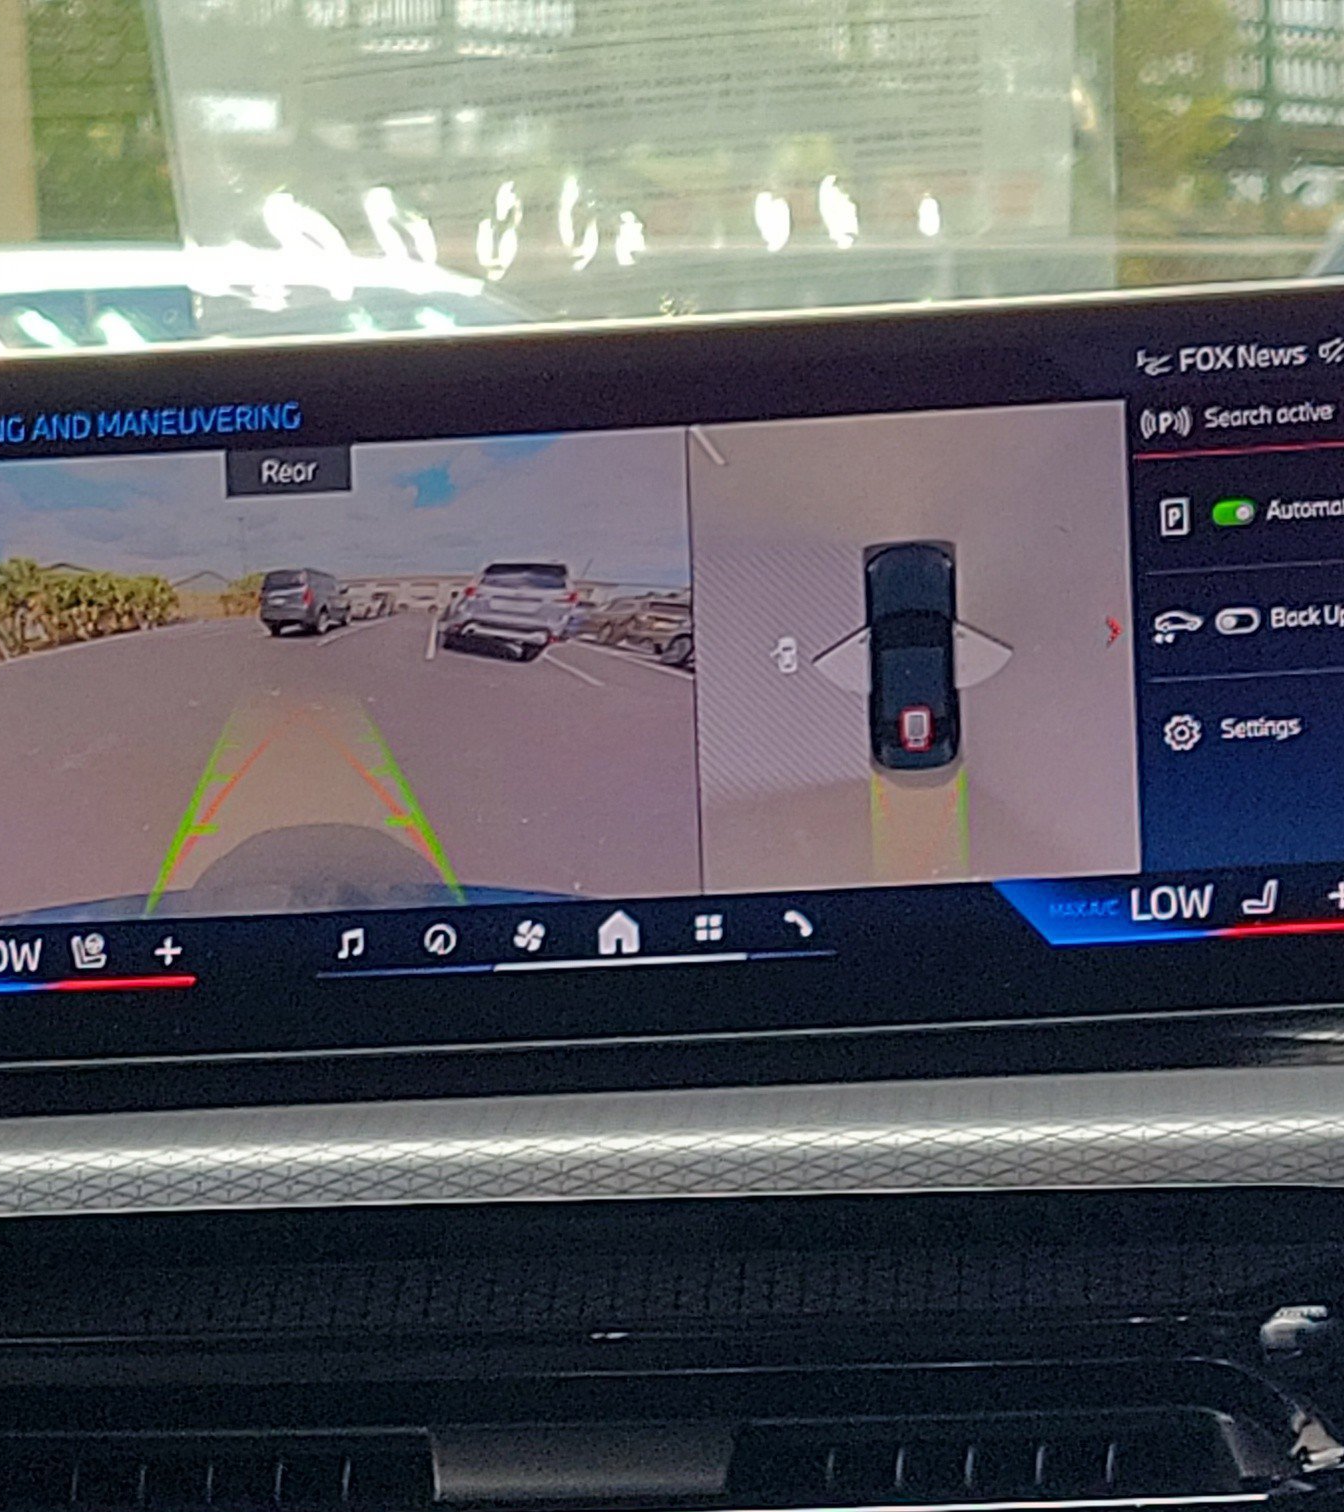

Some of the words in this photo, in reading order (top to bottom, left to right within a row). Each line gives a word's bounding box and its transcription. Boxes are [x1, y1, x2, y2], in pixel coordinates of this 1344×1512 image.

[1179, 347, 1234, 372] FOX
[1237, 342, 1307, 368] News
[32, 411, 90, 442] AND
[96, 401, 302, 438] MANEUVERING
[1204, 404, 1272, 429] Search
[1277, 402, 1335, 425] active
[260, 458, 317, 485] Rear
[1270, 607, 1320, 629] Back
[1221, 716, 1303, 742] Settings
[1130, 884, 1214, 921] LOW
